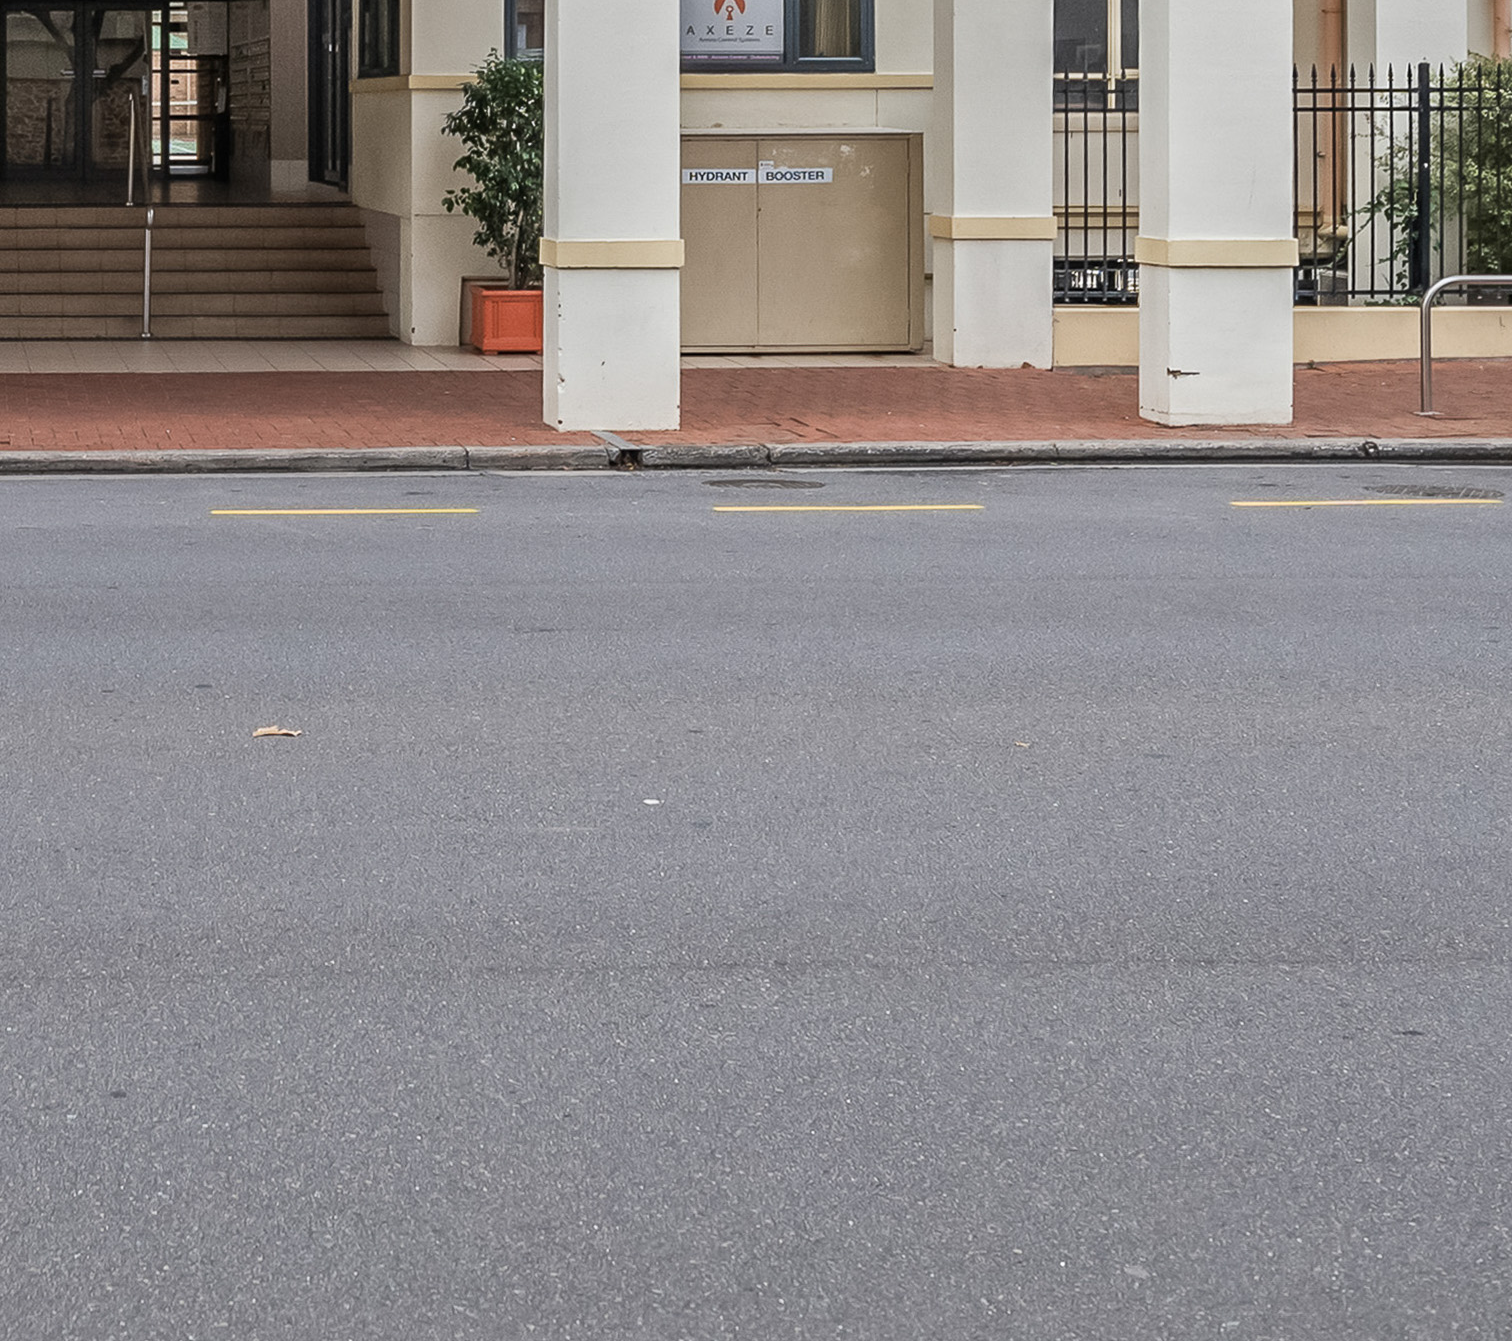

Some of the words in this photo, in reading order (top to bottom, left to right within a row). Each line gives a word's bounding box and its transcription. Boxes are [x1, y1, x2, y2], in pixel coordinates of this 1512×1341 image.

[686, 25, 774, 36] AXEZE
[689, 171, 749, 181] HYDRANT
[766, 171, 825, 181] BOOSTER
